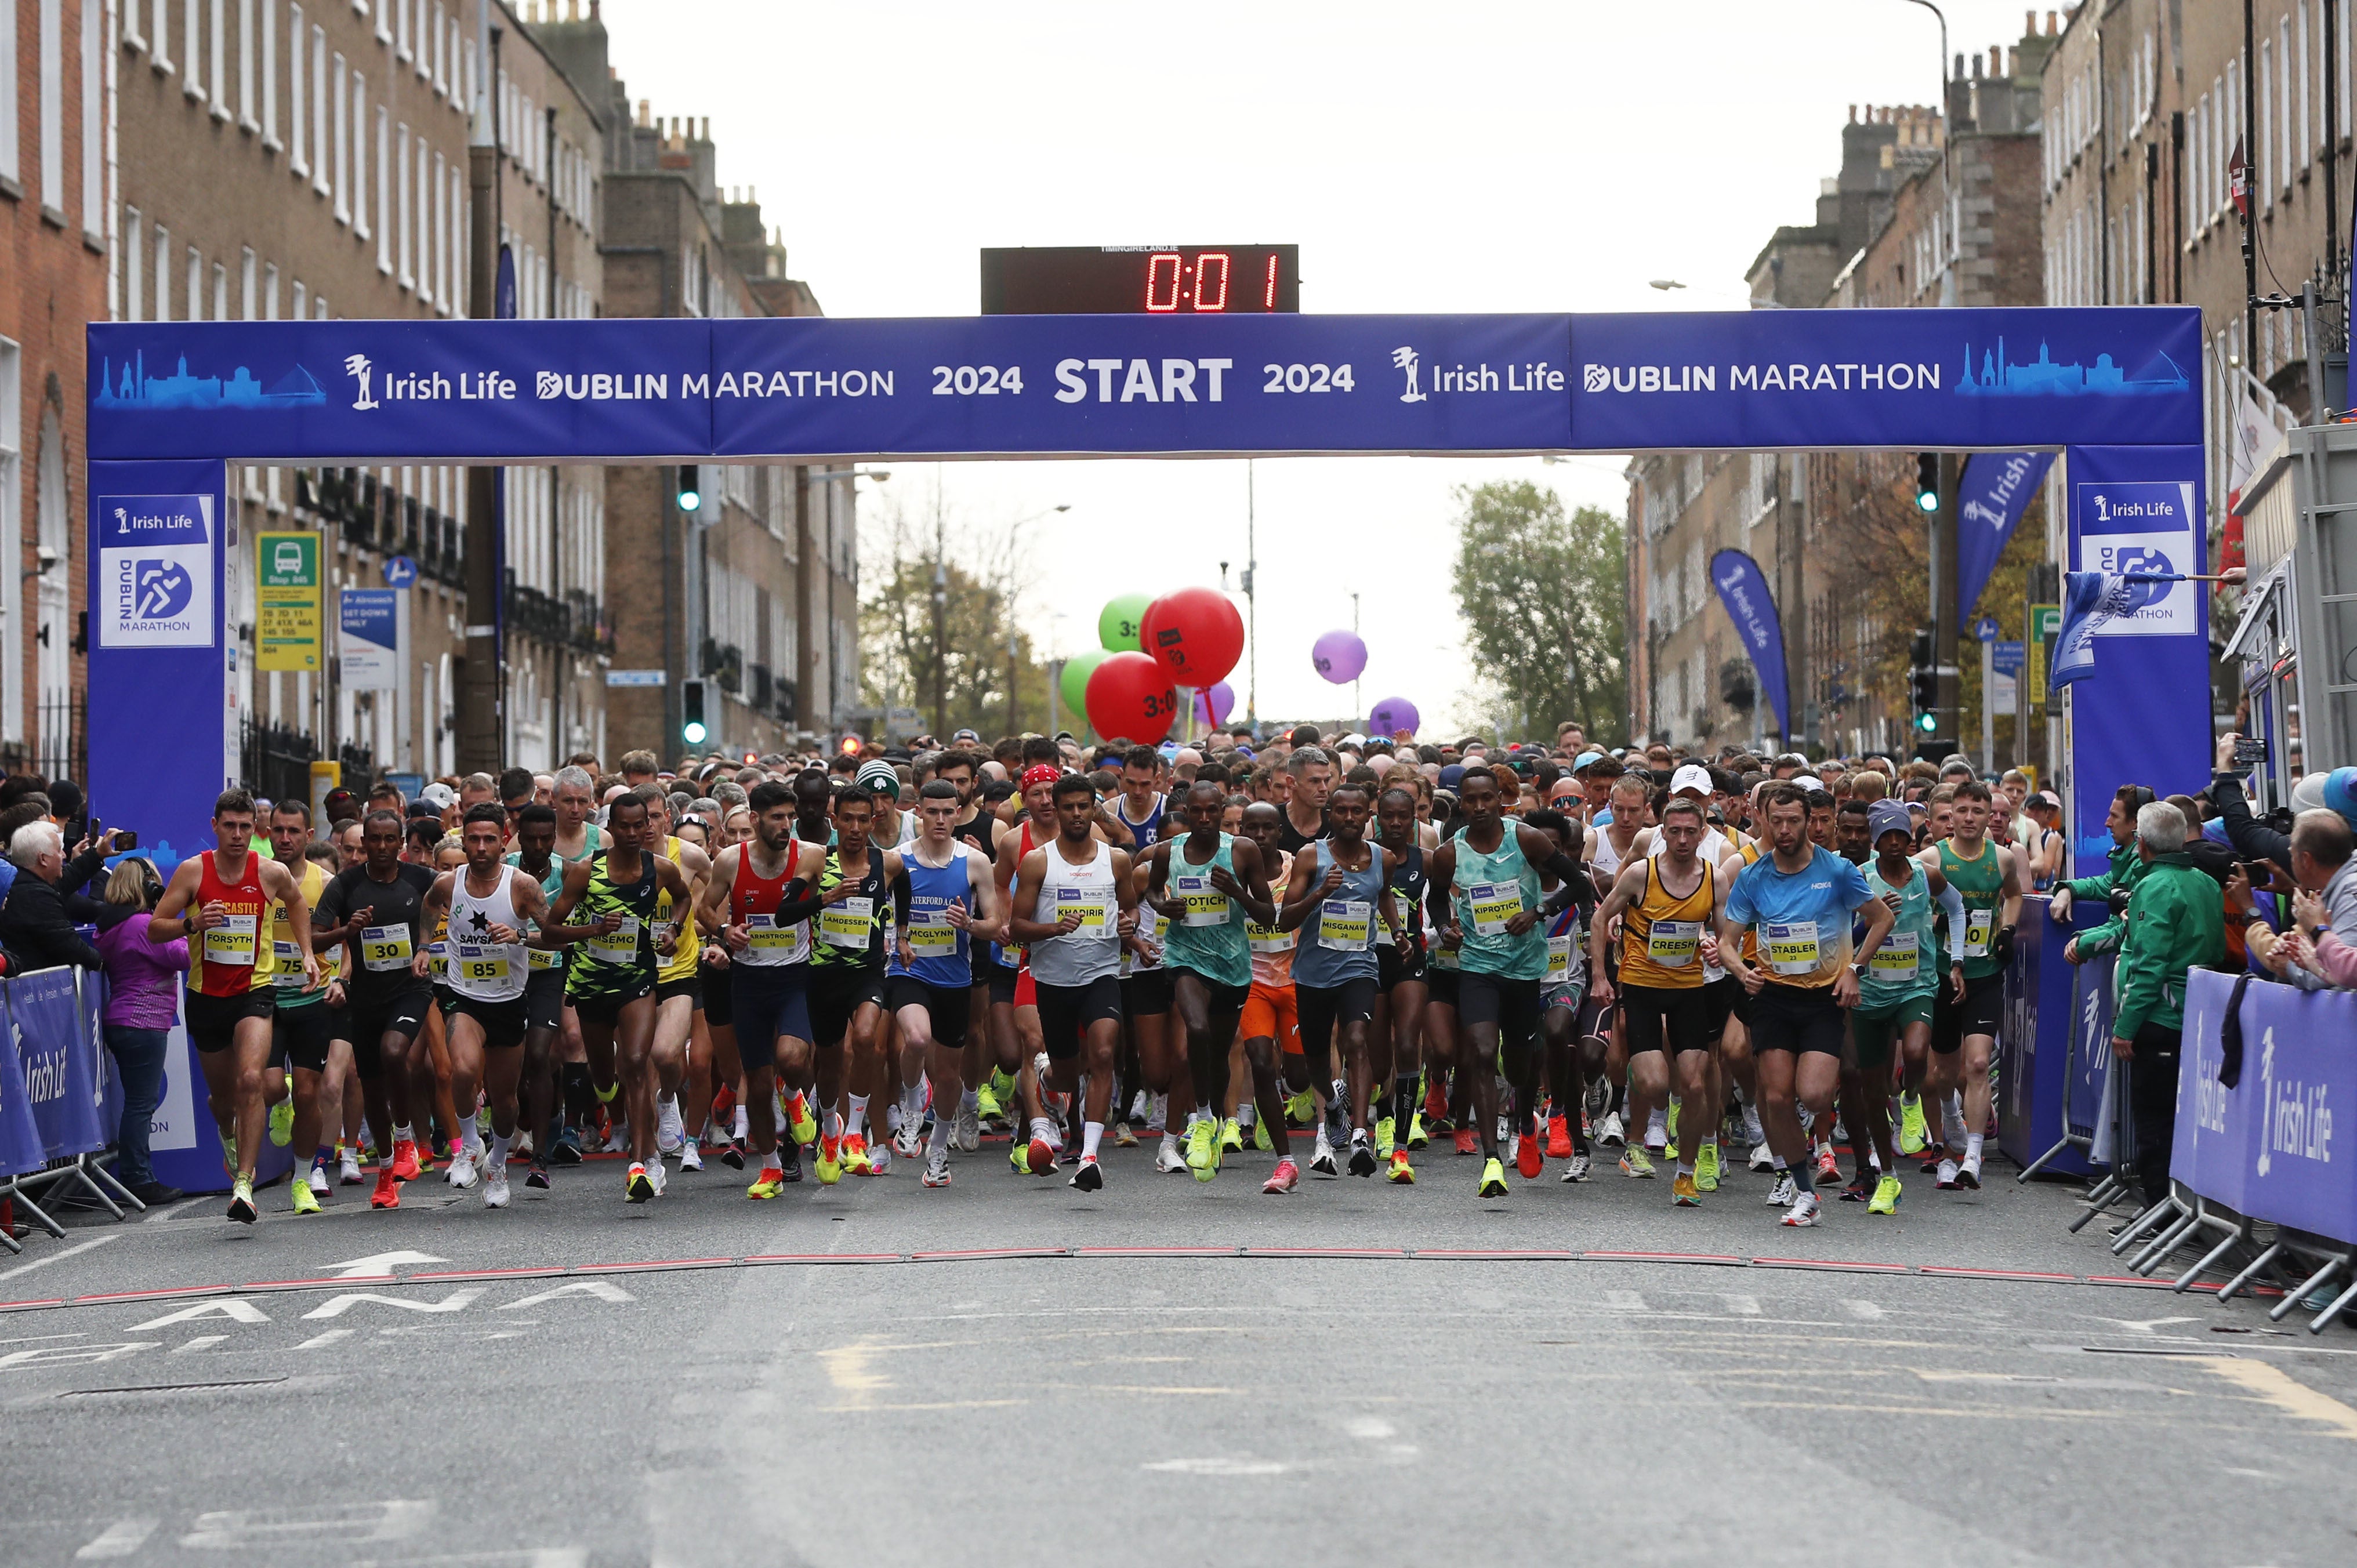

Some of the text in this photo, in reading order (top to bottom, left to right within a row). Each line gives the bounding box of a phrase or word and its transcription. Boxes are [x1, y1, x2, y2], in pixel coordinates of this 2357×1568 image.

[386, 358, 1940, 404] Irish Life DUBLIN MARATHON 2024 START 2024 Irish Life DUBLIN MARATHON
[1988, 457, 2029, 506] Irish
[2112, 502, 2174, 517] Irish Life
[132, 514, 193, 529] Irish Life
[119, 560, 132, 620] DUBLIN
[2114, 609, 2173, 619] ATHON
[119, 621, 190, 631] MARATHON
[1811, 881, 1832, 890] HOKA
[911, 896, 943, 905] ATERFORD
[1474, 901, 1520, 914] KIPROTICH
[824, 916, 869, 926] LAMDESSEM
[1322, 921, 1368, 931] MISGANAW
[207, 934, 252, 943] FORSYTH
[910, 930, 953, 938] MCGLYNN
[1652, 940, 1695, 950] CREESH
[1772, 943, 1816, 954] STABLER
[375, 943, 398, 959] 30
[282, 960, 302, 972] 75
[473, 963, 496, 977] 85
[2273, 1080, 2304, 1156] Irish
[2305, 1083, 2333, 1163] Life
